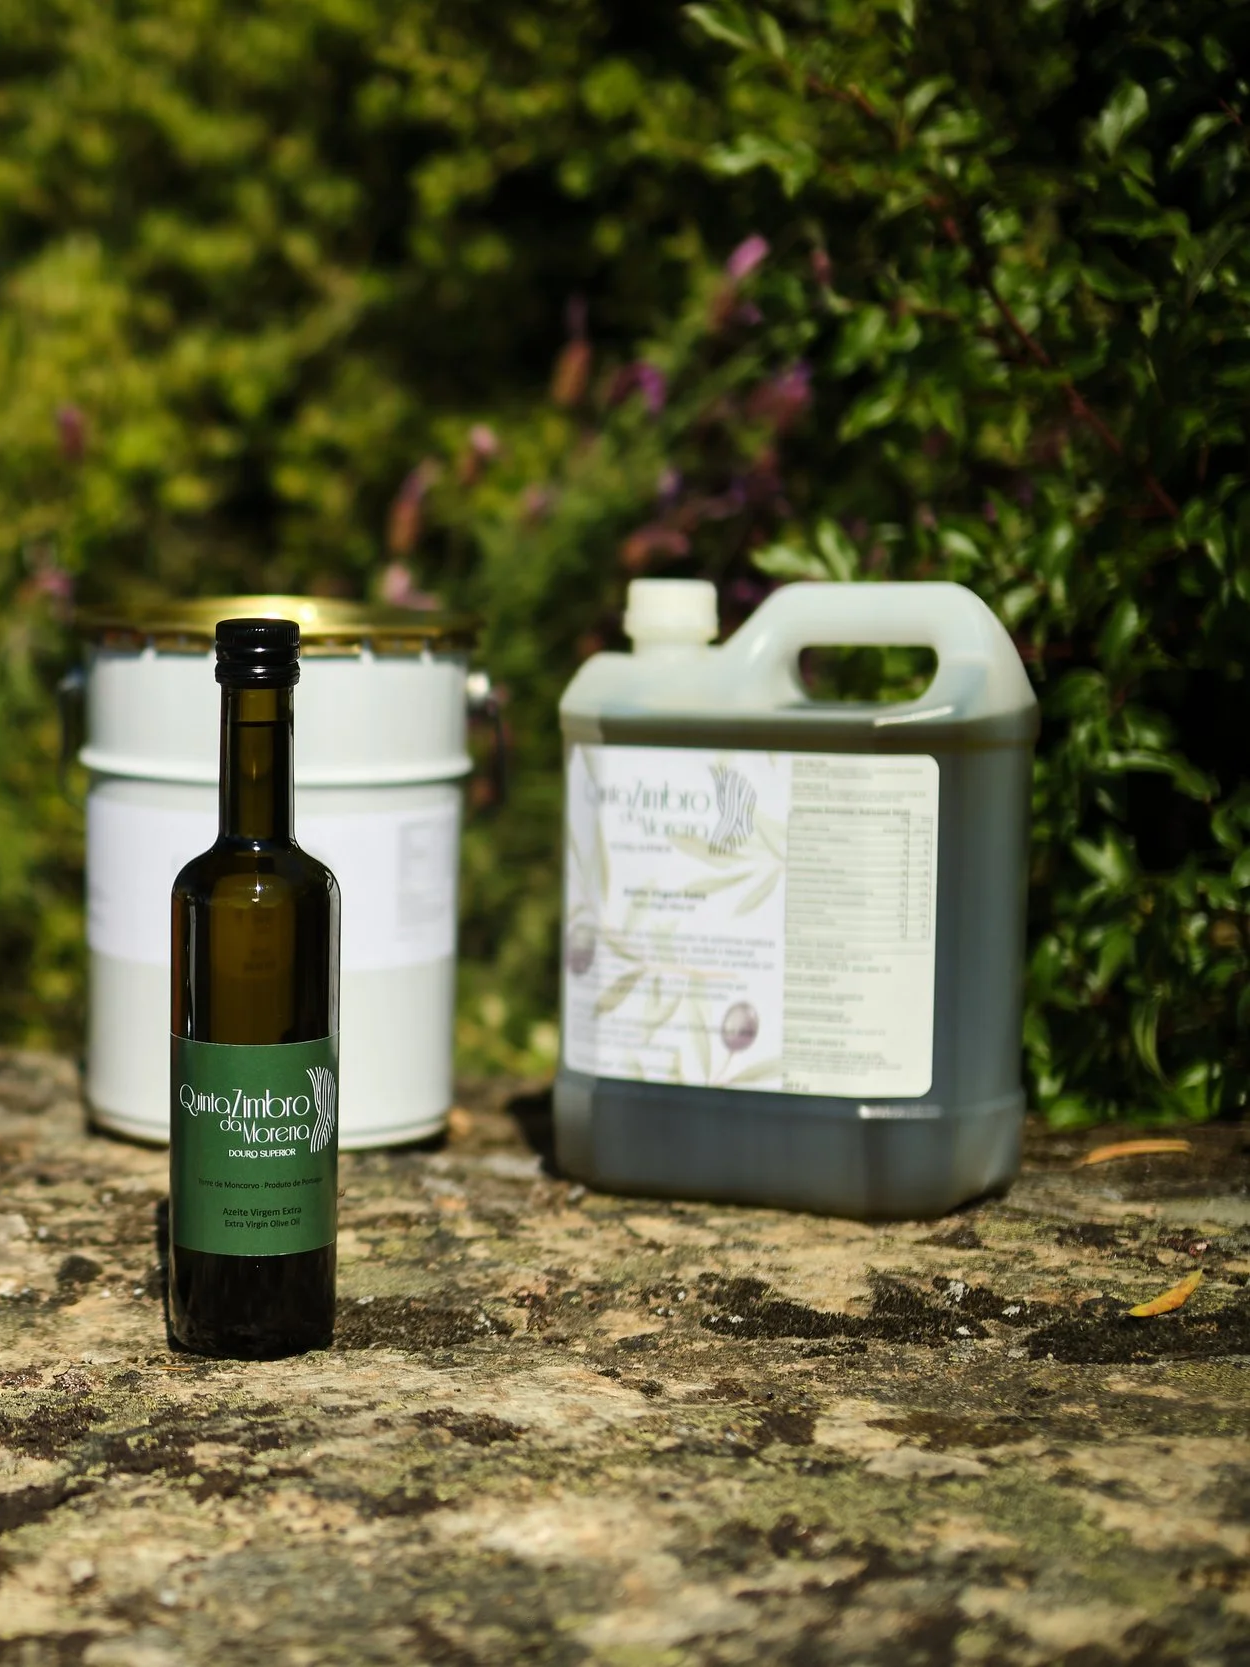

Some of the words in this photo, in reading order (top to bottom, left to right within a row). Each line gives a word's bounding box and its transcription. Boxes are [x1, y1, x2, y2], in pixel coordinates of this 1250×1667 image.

[179, 1084, 231, 1117] Quinta
[231, 1089, 310, 1118] Zimbro
[219, 1115, 242, 1132] da
[242, 1121, 310, 1144] Morena
[228, 1149, 258, 1159] DOURO
[259, 1148, 296, 1158] SUPERIOR
[215, 1180, 223, 1188] de
[224, 1181, 260, 1189] Moncorvo
[264, 1181, 291, 1189] Produto
[292, 1179, 301, 1187] de
[222, 1208, 248, 1216] Azeite
[250, 1208, 280, 1217] Virgem
[282, 1206, 302, 1215] Extra
[224, 1220, 244, 1228] Extra
[246, 1220, 268, 1229] Virgin
[270, 1219, 289, 1228] Olive
[290, 1218, 300, 1226] Oil
